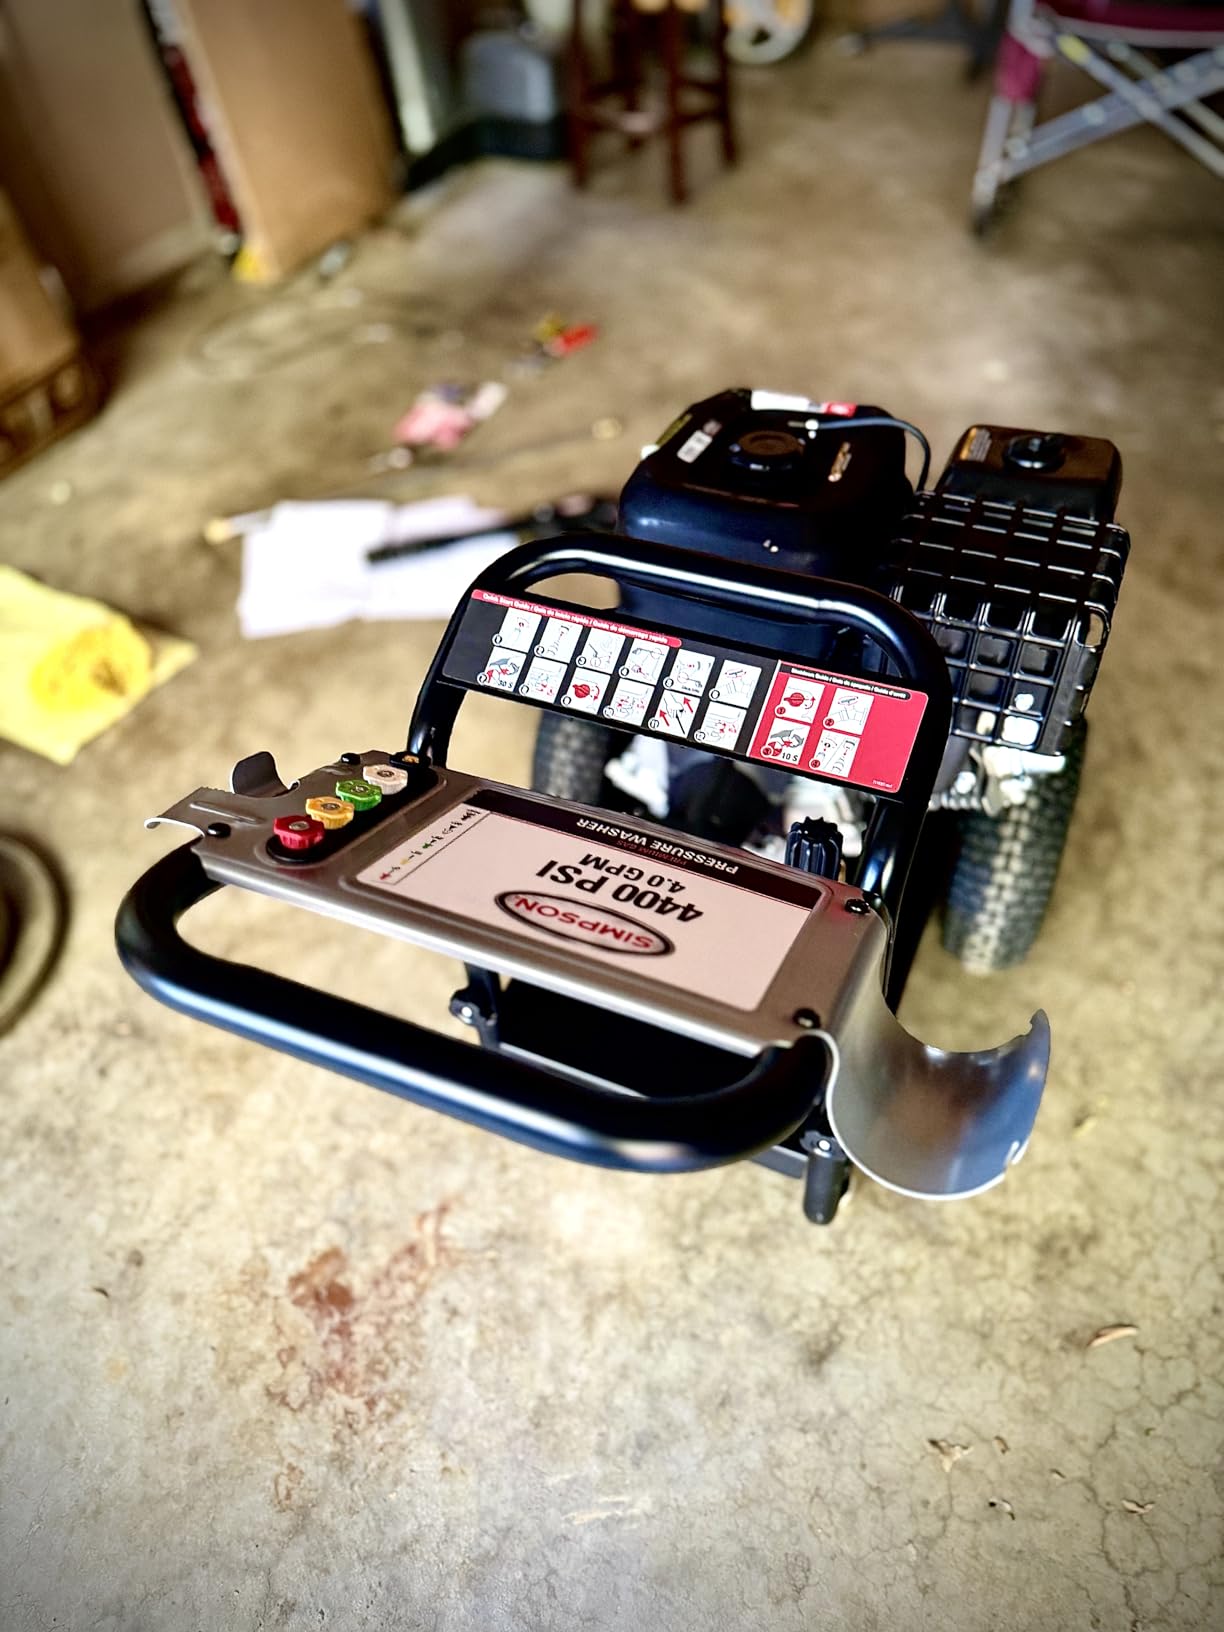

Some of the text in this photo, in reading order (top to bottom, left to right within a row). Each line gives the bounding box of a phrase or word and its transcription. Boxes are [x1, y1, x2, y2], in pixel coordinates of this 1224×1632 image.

[782, 752, 791, 761] 10
[576, 817, 740, 875] PRESSURE WASHER
[616, 839, 688, 866] PREMIUM GAS
[535, 860, 704, 923] 4400 PSI
[578, 853, 687, 894] 4.0 GPM
[513, 896, 654, 949] SIMPSON
